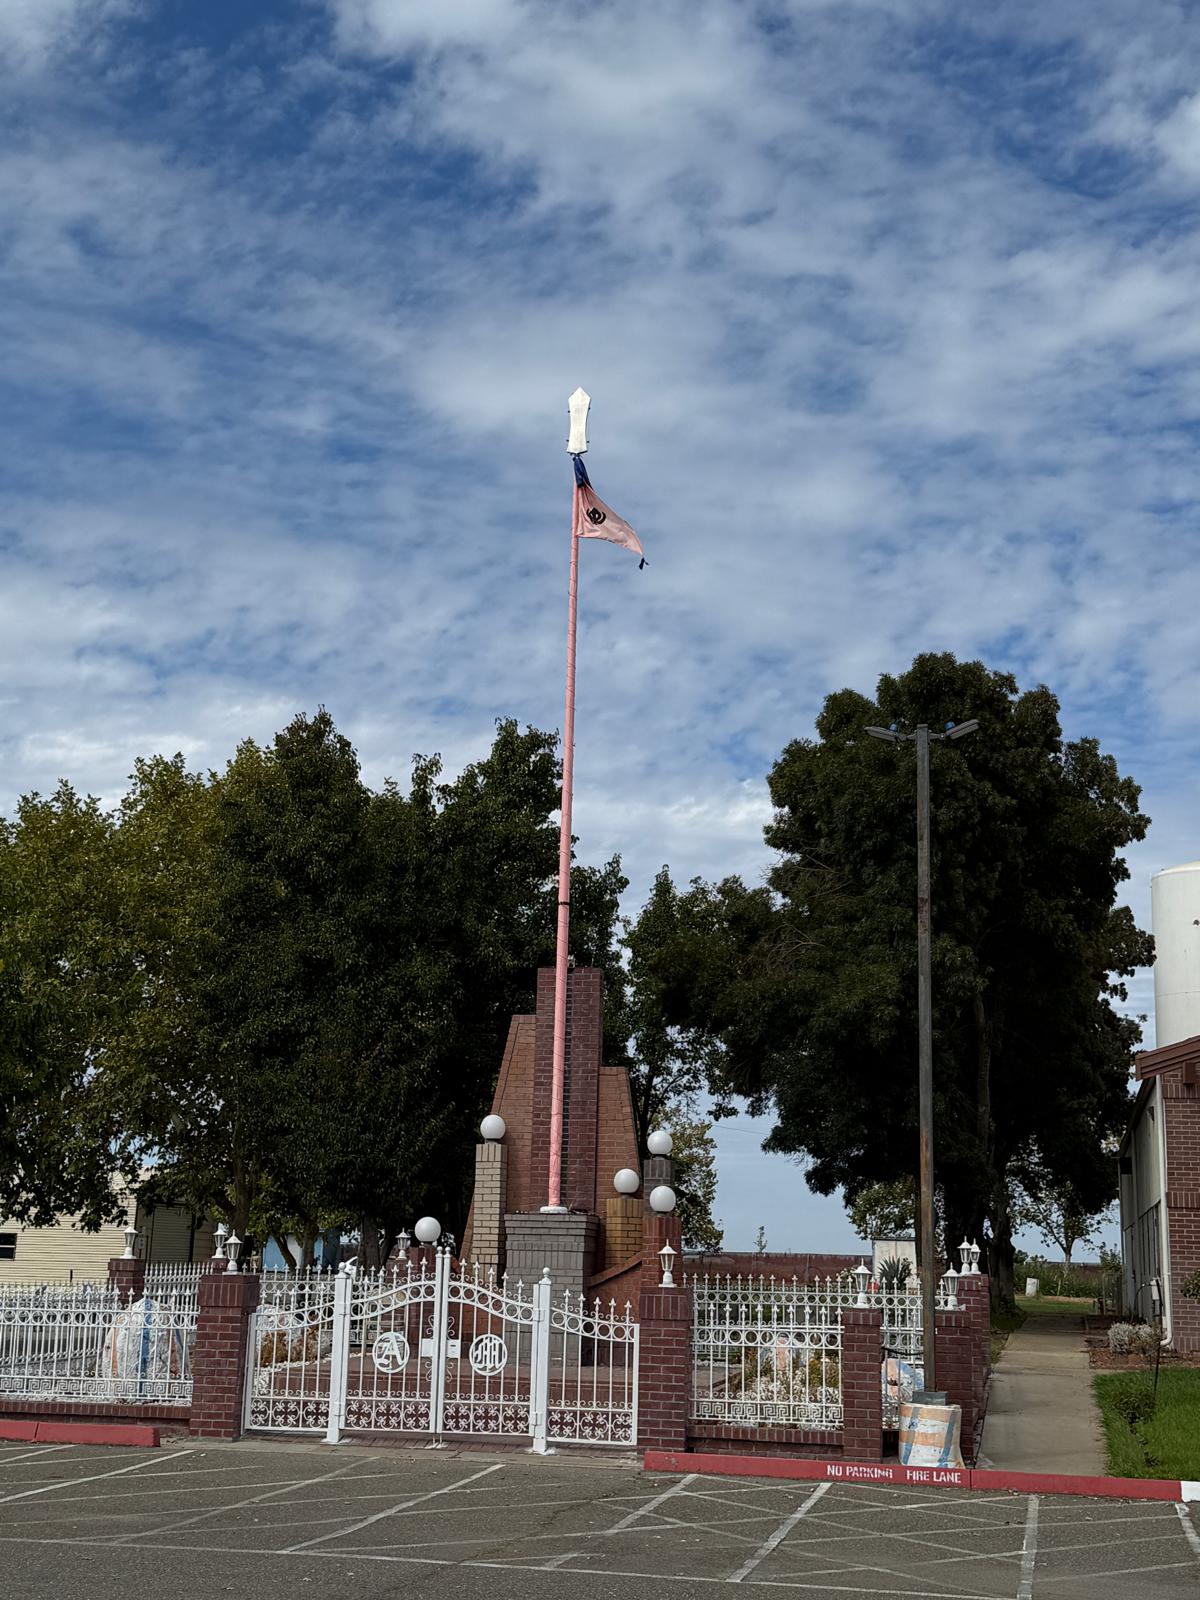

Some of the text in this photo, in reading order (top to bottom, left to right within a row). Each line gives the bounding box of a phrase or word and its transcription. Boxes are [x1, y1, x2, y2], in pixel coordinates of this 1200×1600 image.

[827, 1465, 961, 1483] NO PARKING FIRE LANE
